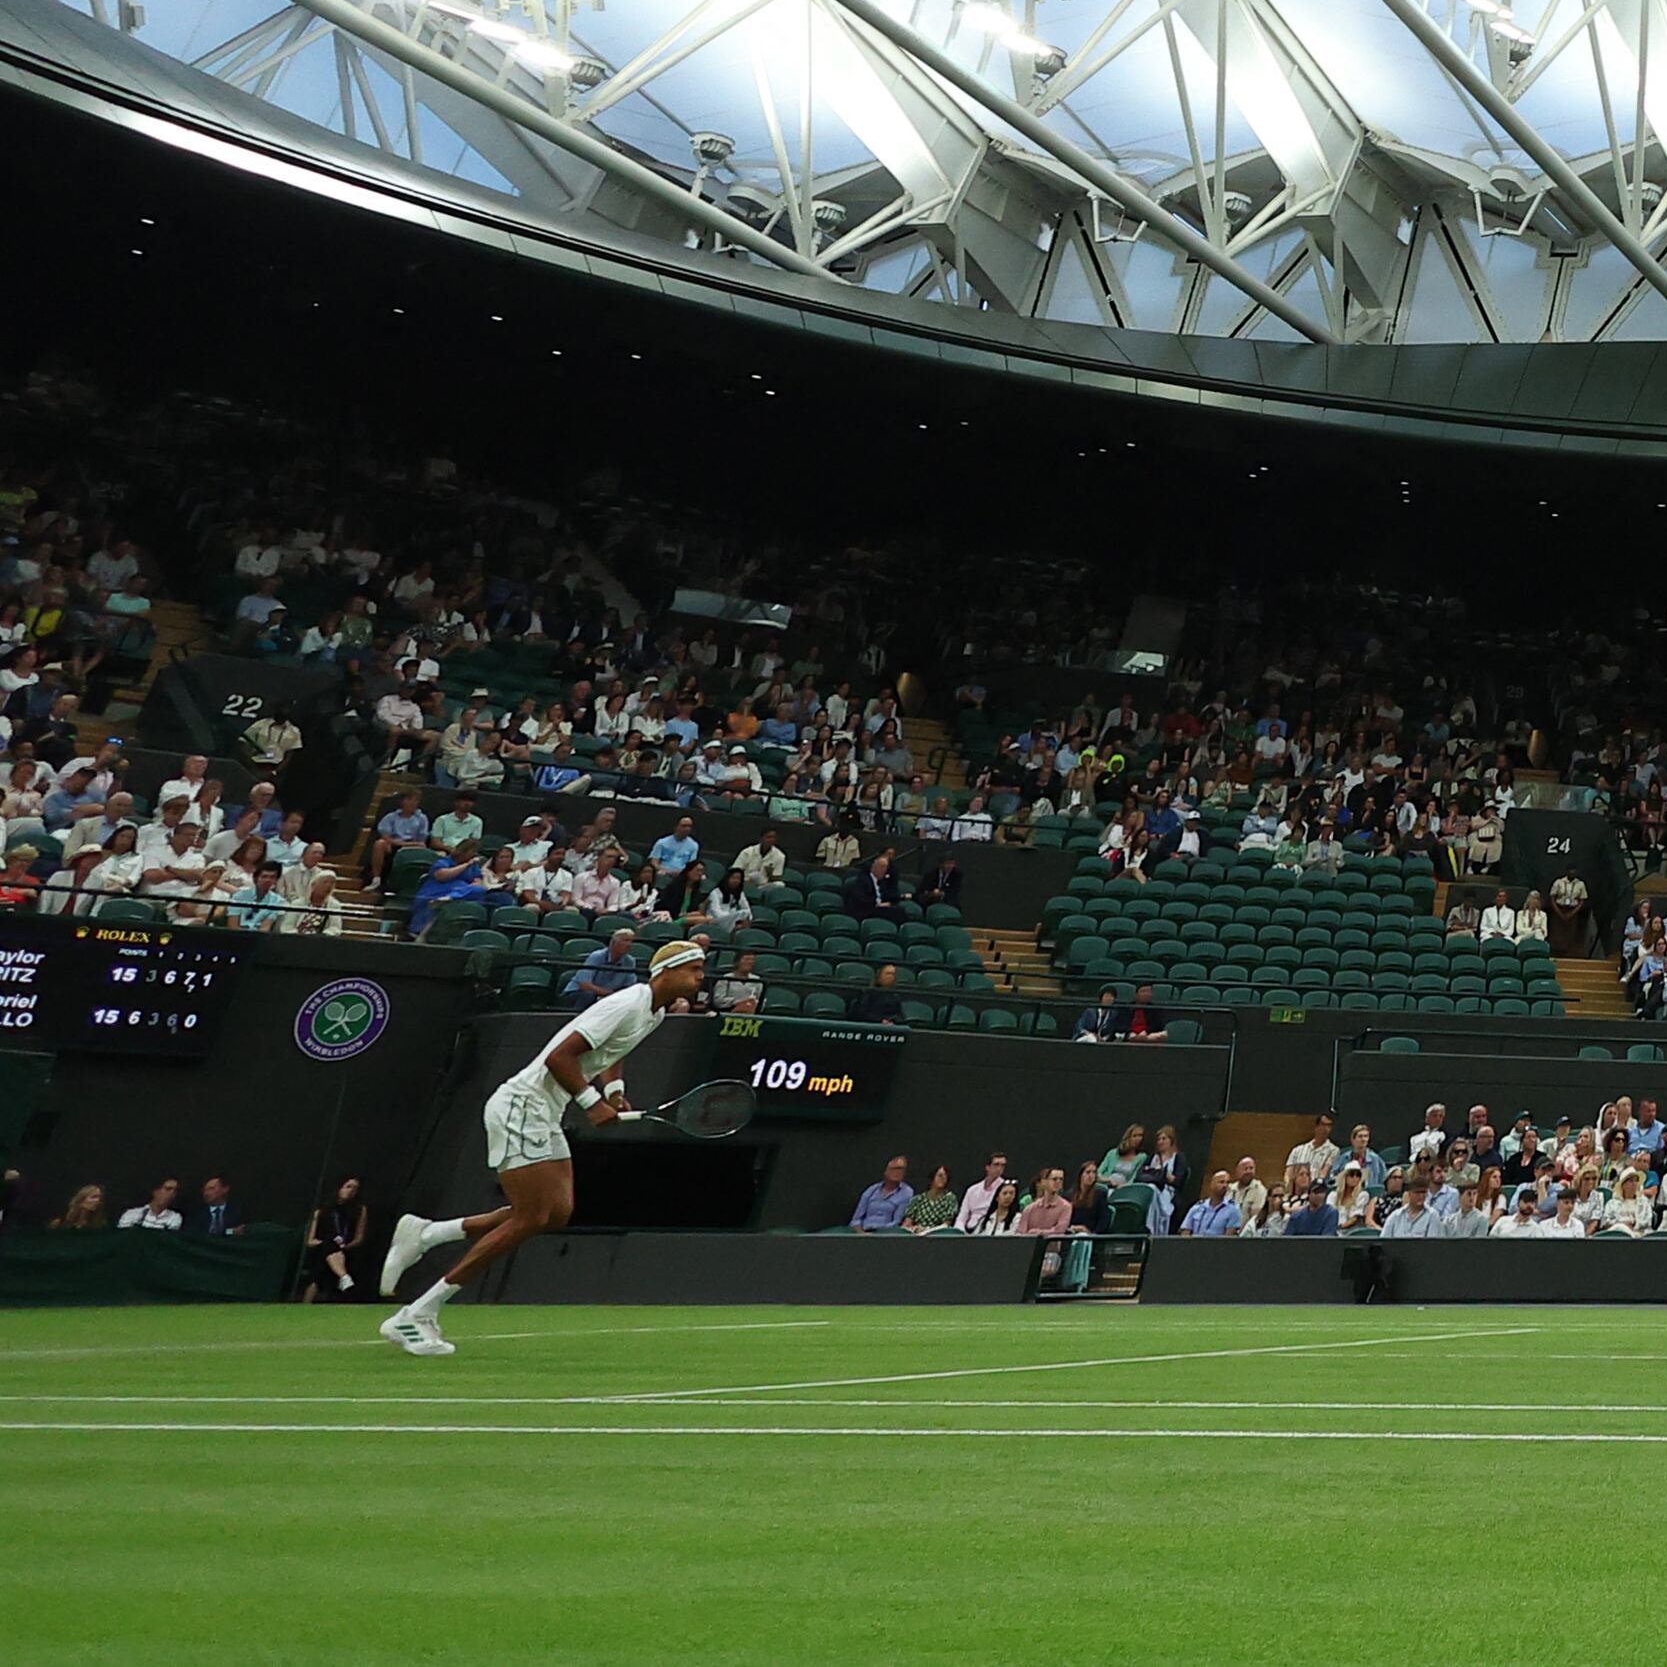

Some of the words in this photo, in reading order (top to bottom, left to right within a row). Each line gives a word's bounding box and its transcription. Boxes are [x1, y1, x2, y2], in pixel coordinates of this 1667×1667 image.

[221, 694, 263, 718] 22
[1547, 837, 1571, 854] 24
[96, 928, 152, 944] ROLEX
[118, 948, 148, 958] POINTS
[111, 967, 138, 983] 15
[145, 969, 158, 983] 3
[164, 970, 178, 985] 6
[183, 971, 197, 986] 7
[202, 973, 213, 987] 1
[304, 997, 322, 1015] THE
[0, 1012, 34, 1027] LO
[94, 1009, 120, 1025] 15
[128, 1010, 142, 1025] 6
[147, 1012, 160, 1026] 3
[166, 1013, 179, 1027] 6
[184, 1013, 197, 1028] 0
[720, 1017, 764, 1038] IBM
[822, 1030, 862, 1040] RANGE
[866, 1033, 905, 1043] ROVER
[750, 1058, 807, 1090] 109
[807, 1075, 854, 1096] mph
